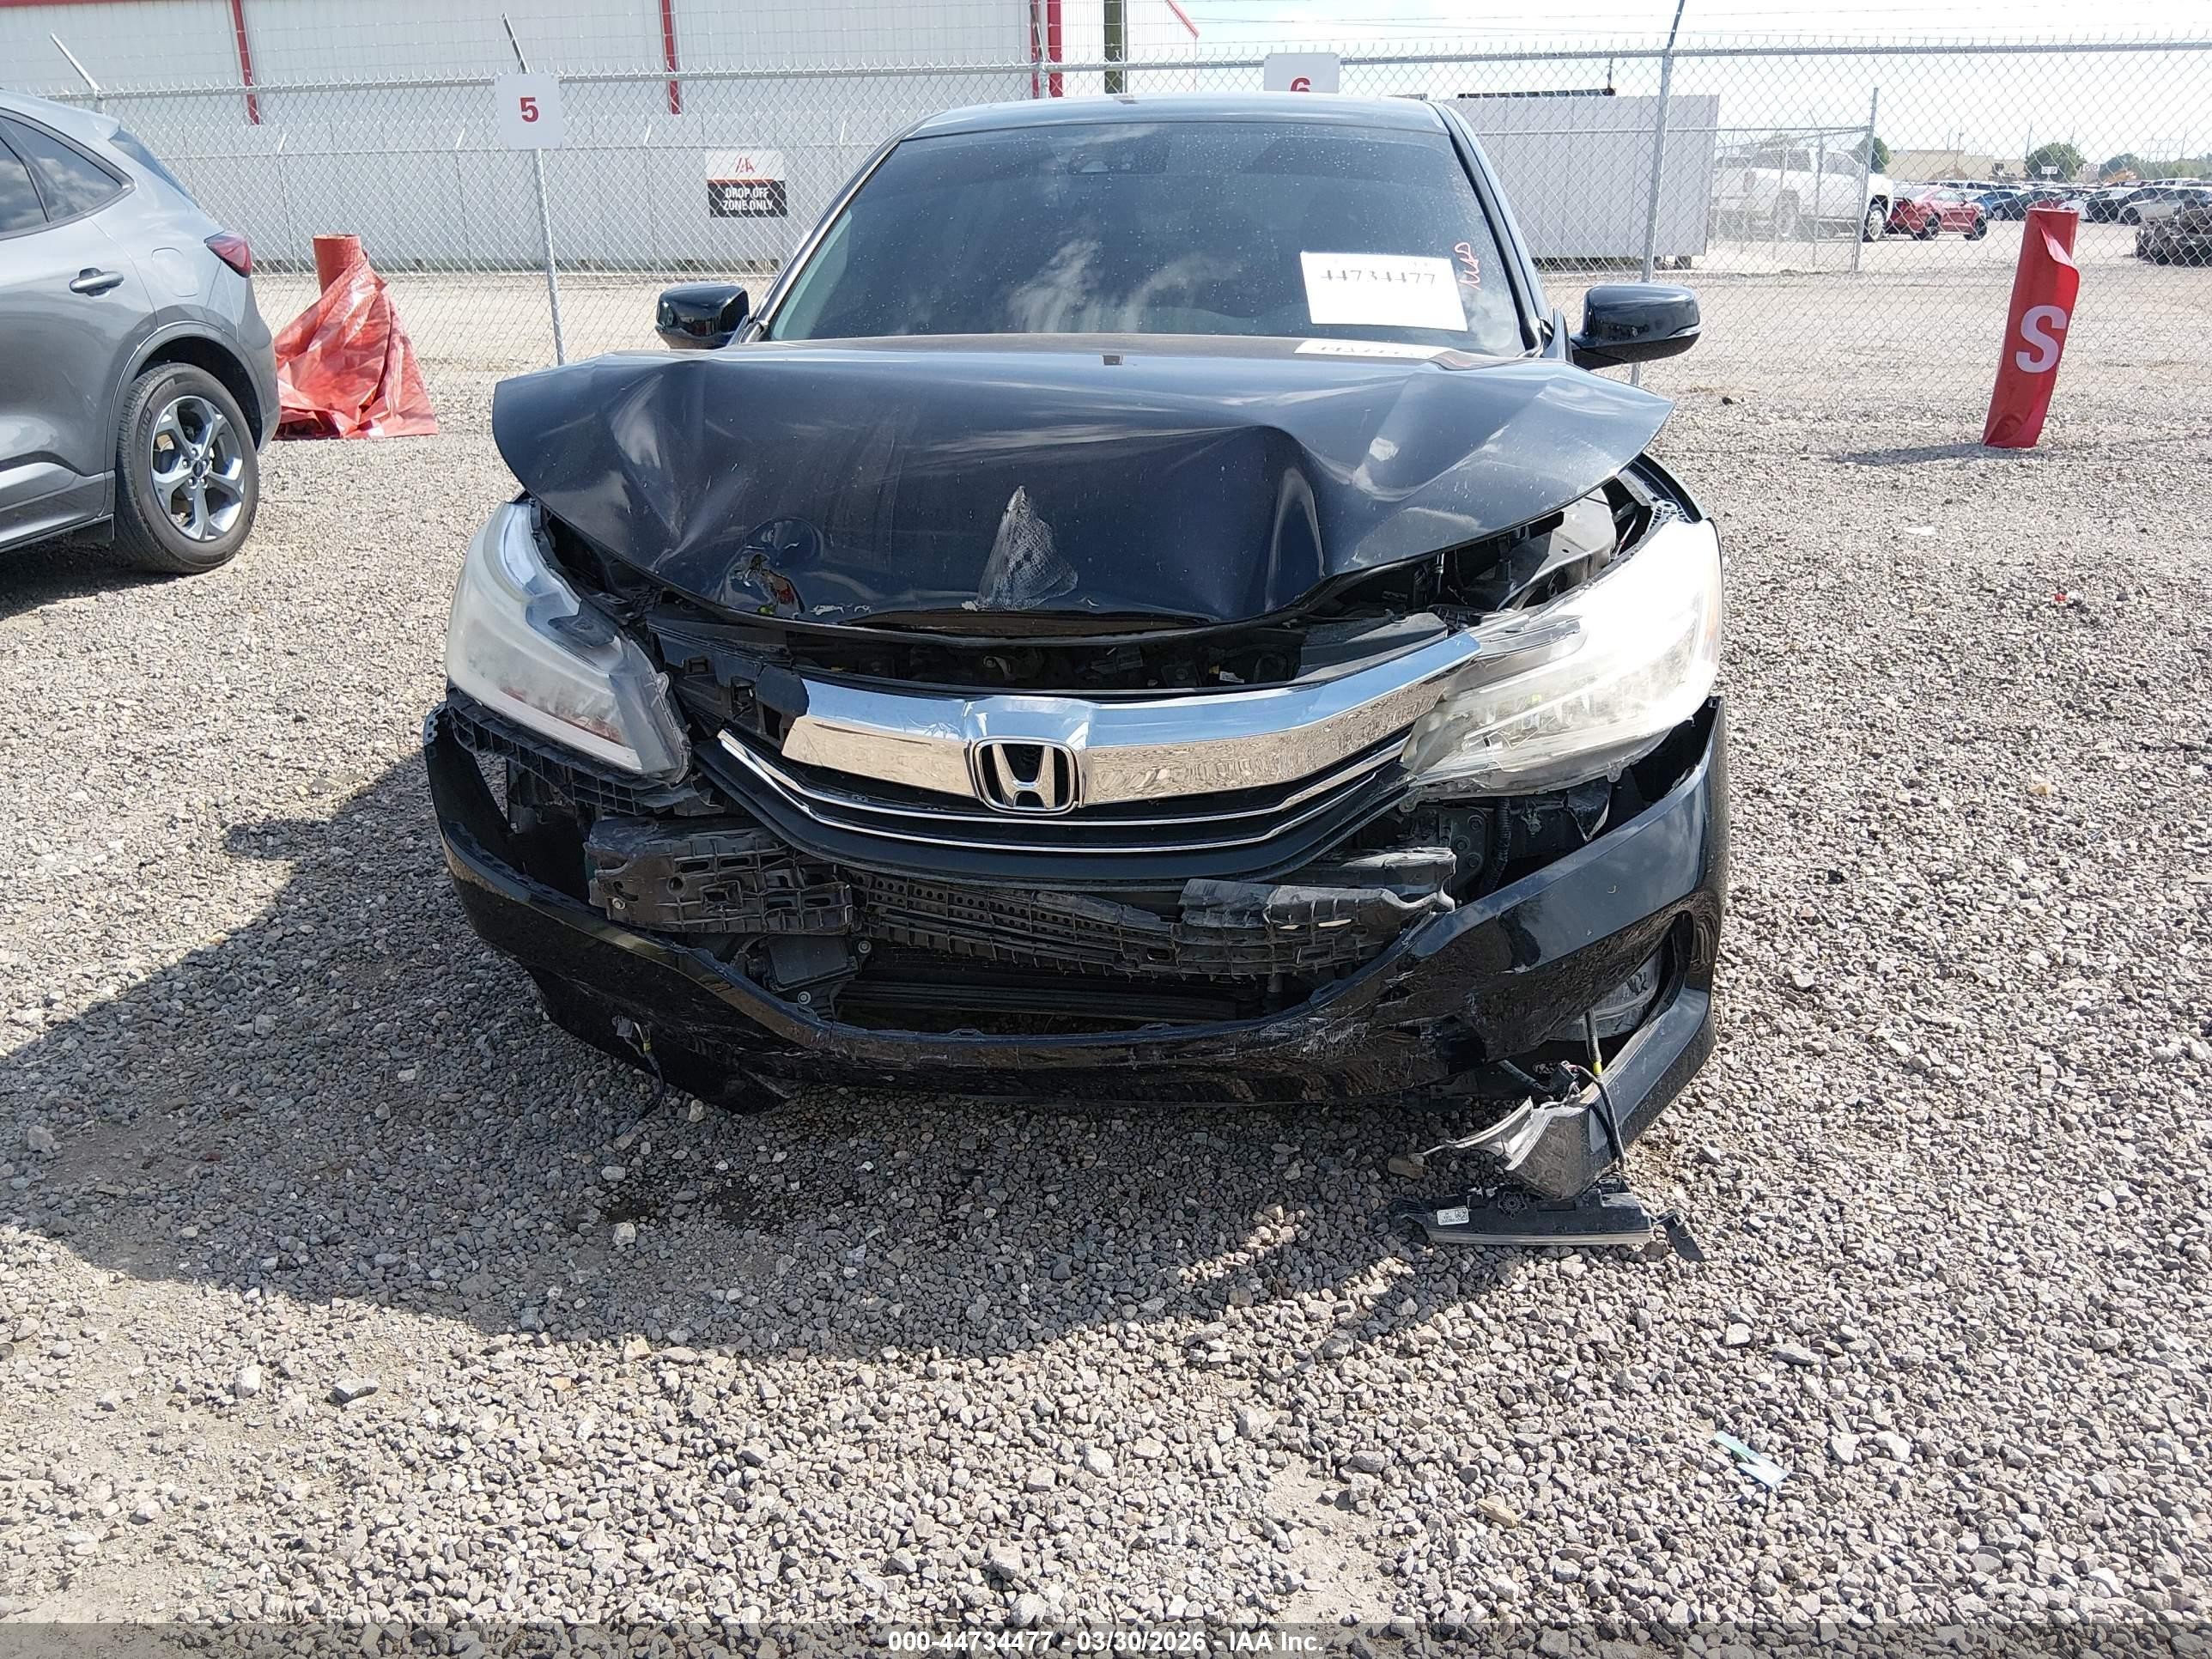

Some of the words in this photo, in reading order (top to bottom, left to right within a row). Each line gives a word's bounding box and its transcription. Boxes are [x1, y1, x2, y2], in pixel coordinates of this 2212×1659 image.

[520, 96, 539, 123] 5
[725, 188, 750, 198] DROP
[753, 188, 769, 199] OFF
[723, 200, 747, 211] ZONE
[750, 200, 773, 211] ONLY
[1321, 270, 1436, 285] 44734477
[2015, 305, 2067, 373] S
